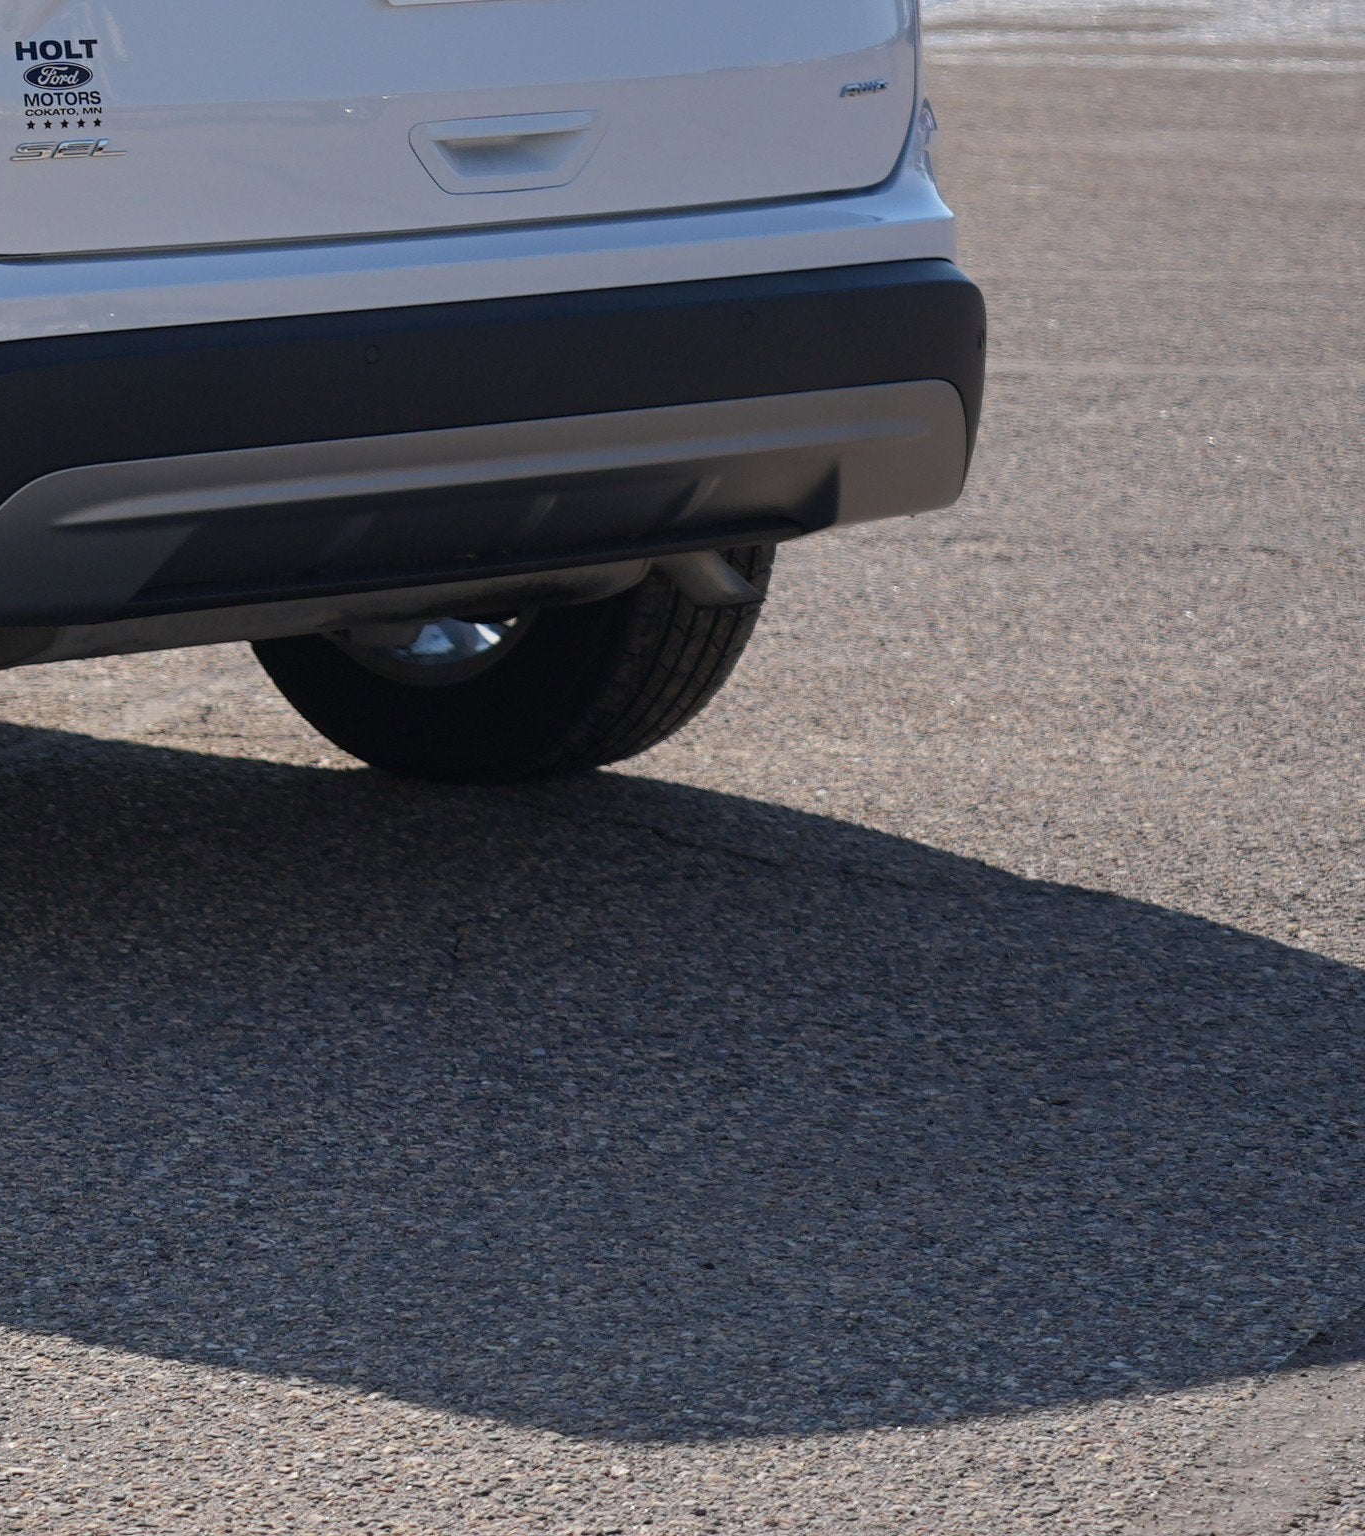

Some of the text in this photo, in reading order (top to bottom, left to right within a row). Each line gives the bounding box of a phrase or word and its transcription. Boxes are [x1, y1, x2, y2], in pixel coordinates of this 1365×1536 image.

[15, 39, 98, 61] HOLT
[37, 66, 80, 85] Ford
[23, 91, 102, 107] MOTORS
[25, 107, 102, 116] COKATO, MN
[10, 139, 127, 161] SEL
